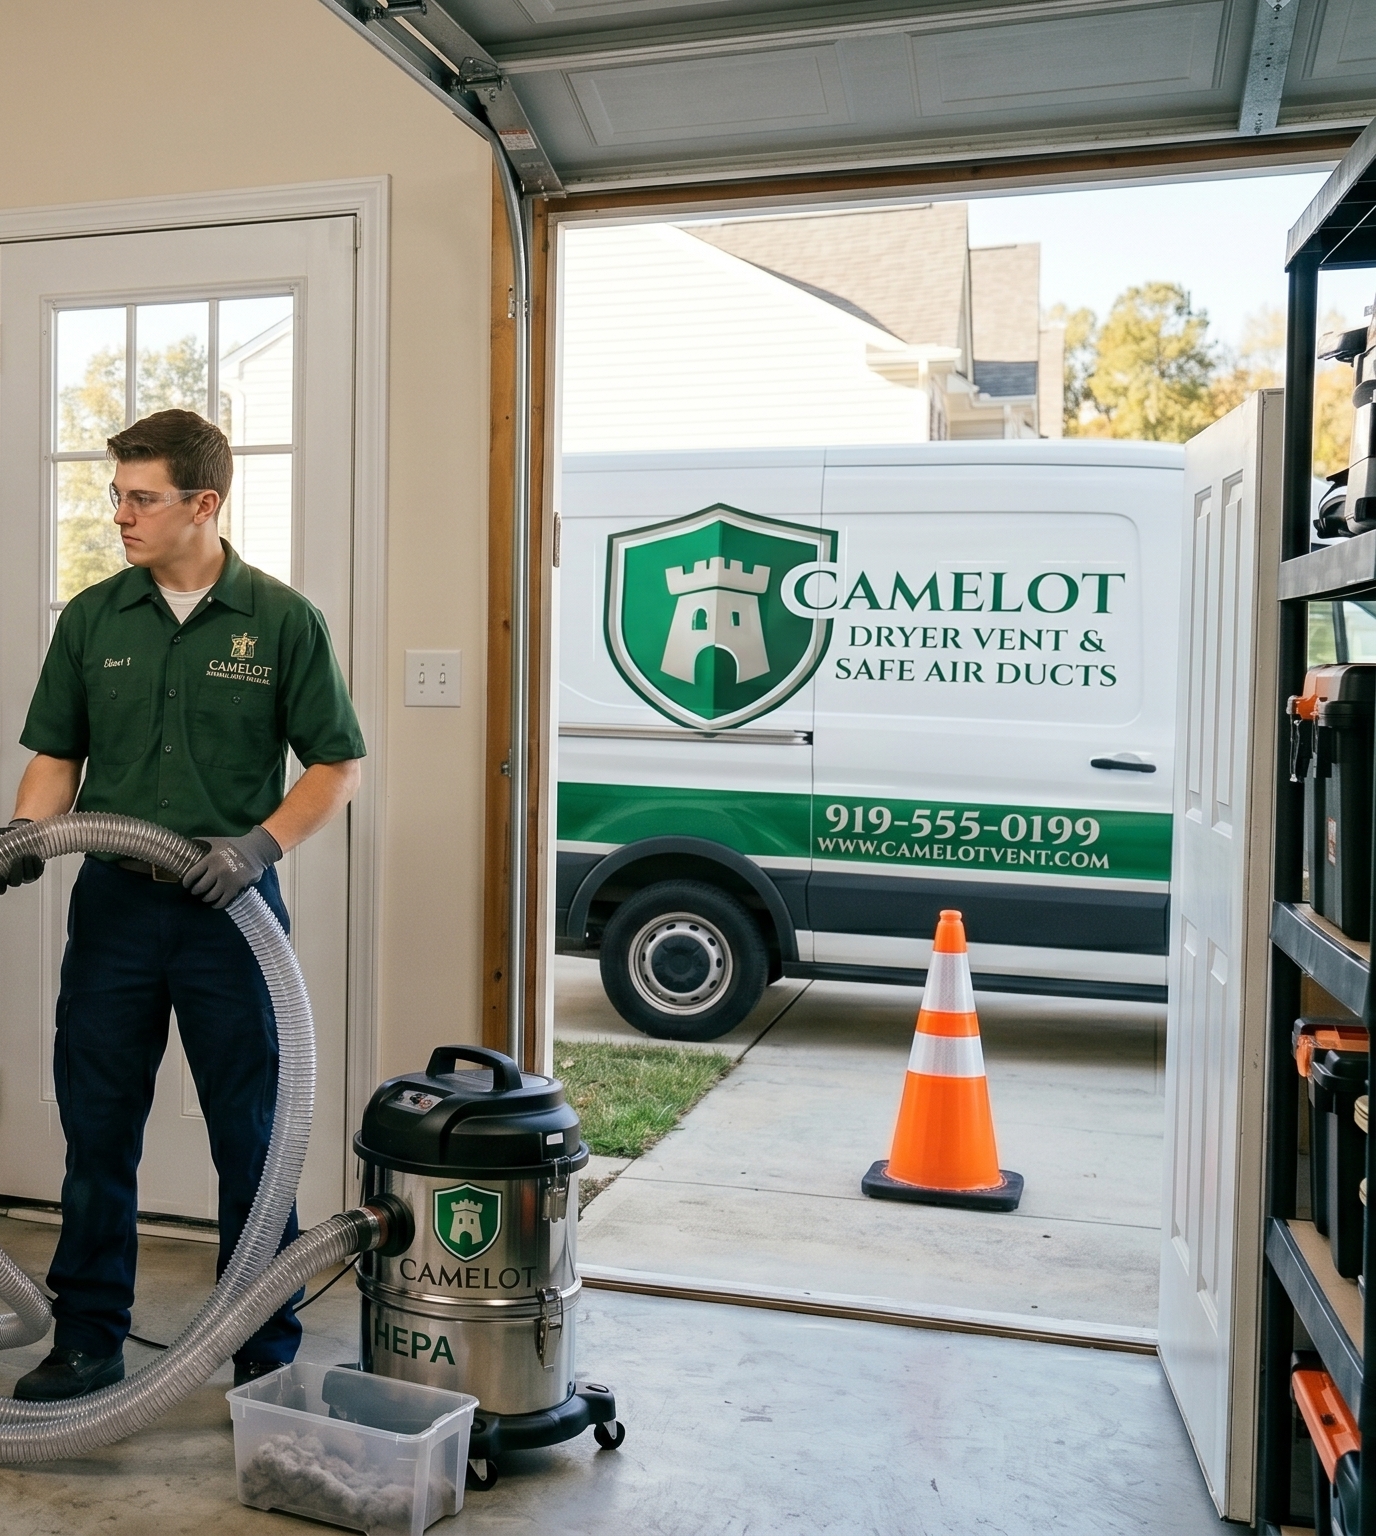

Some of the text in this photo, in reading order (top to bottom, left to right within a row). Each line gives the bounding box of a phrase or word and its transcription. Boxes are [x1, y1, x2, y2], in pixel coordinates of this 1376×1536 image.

[794, 570, 1126, 614] CAMELOT
[848, 625, 1107, 653] DRYER VENT &
[209, 660, 272, 677] CAMELOT
[835, 657, 1117, 687] SAFE AIR DUCTS
[825, 804, 1101, 846] 919-555-0199
[817, 837, 1110, 869] WWW.CAMELOTVENT.COM
[399, 1258, 537, 1289] CAMELOT
[375, 1318, 456, 1366] HEPA
